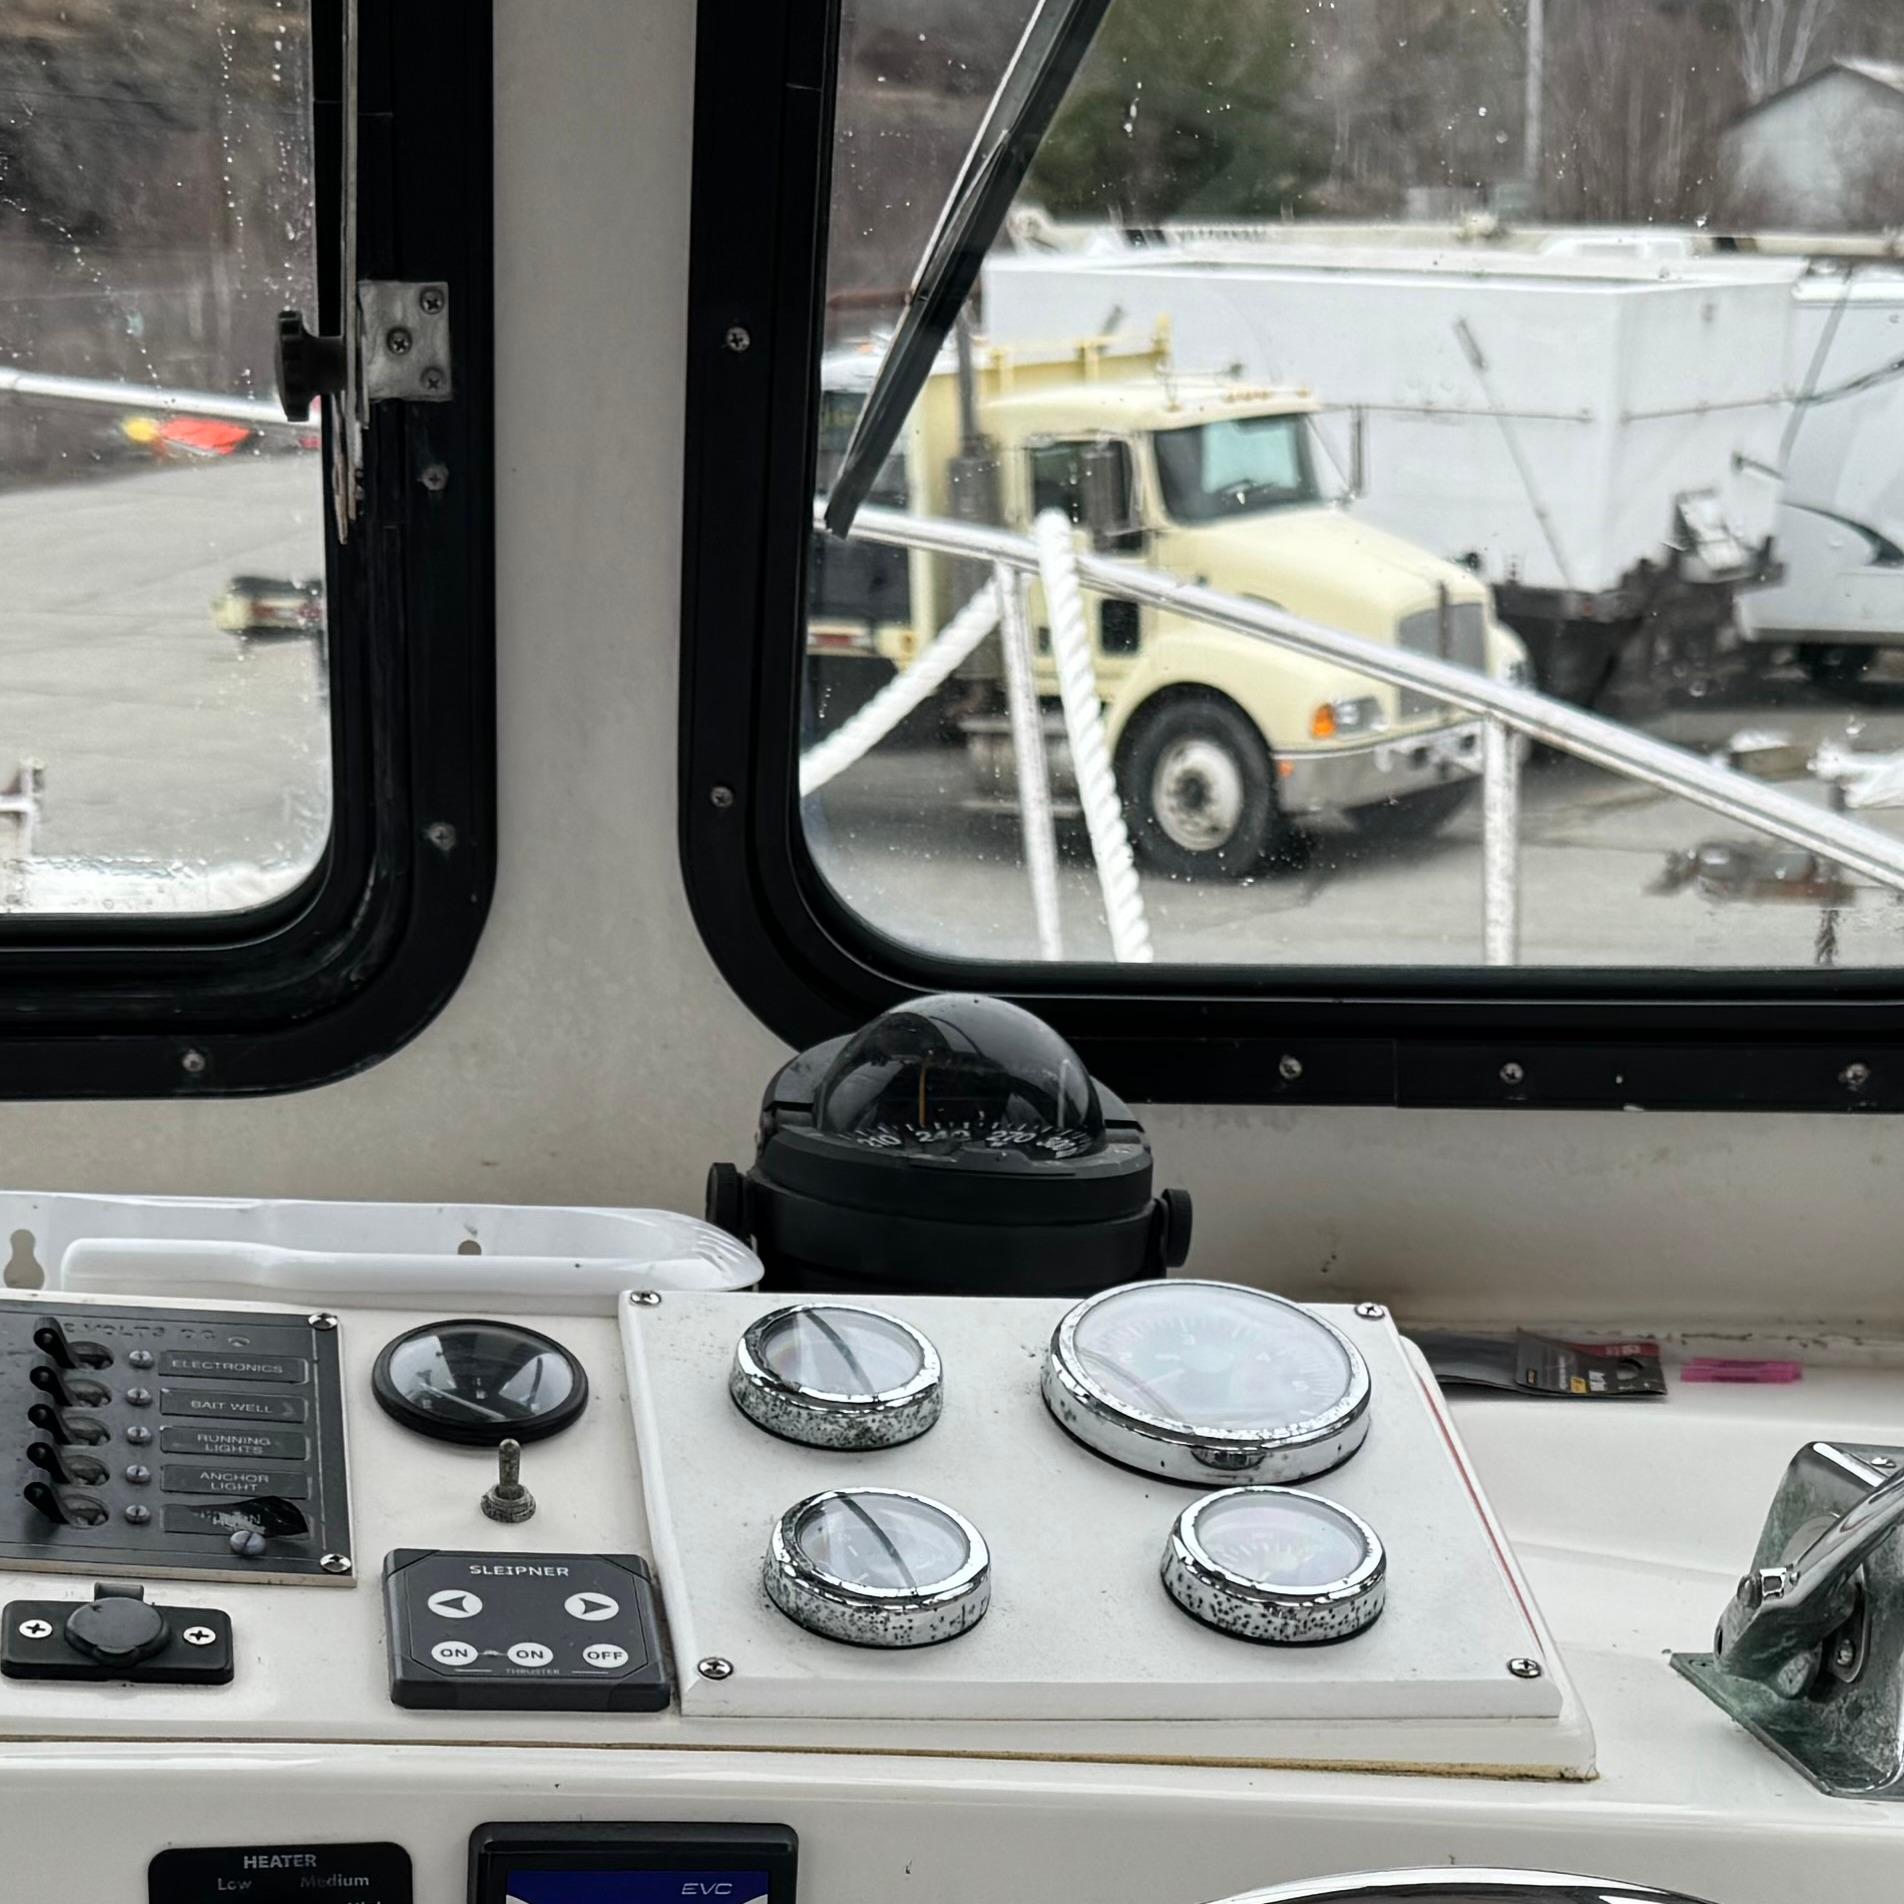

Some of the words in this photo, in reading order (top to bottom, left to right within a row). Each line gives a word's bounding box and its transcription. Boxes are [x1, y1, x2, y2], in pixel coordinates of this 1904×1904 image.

[171, 1358, 284, 1374] ELECTRONICS
[190, 1400, 227, 1411] BAIT
[229, 1402, 273, 1414] WELL
[197, 1433, 271, 1447] RUNNING
[205, 1443, 263, 1456] LIGHTS
[199, 1471, 270, 1484] ANCHOR
[210, 1480, 258, 1492] LIGHT
[469, 1564, 570, 1578] SLEIPNER
[440, 1648, 469, 1659] ON
[515, 1649, 545, 1660] ON
[587, 1650, 624, 1662] OFF
[242, 1853, 318, 1869] HEATER
[217, 1877, 253, 1892] Low
[299, 1873, 371, 1889] Medium
[680, 1882, 734, 1896] EVC
